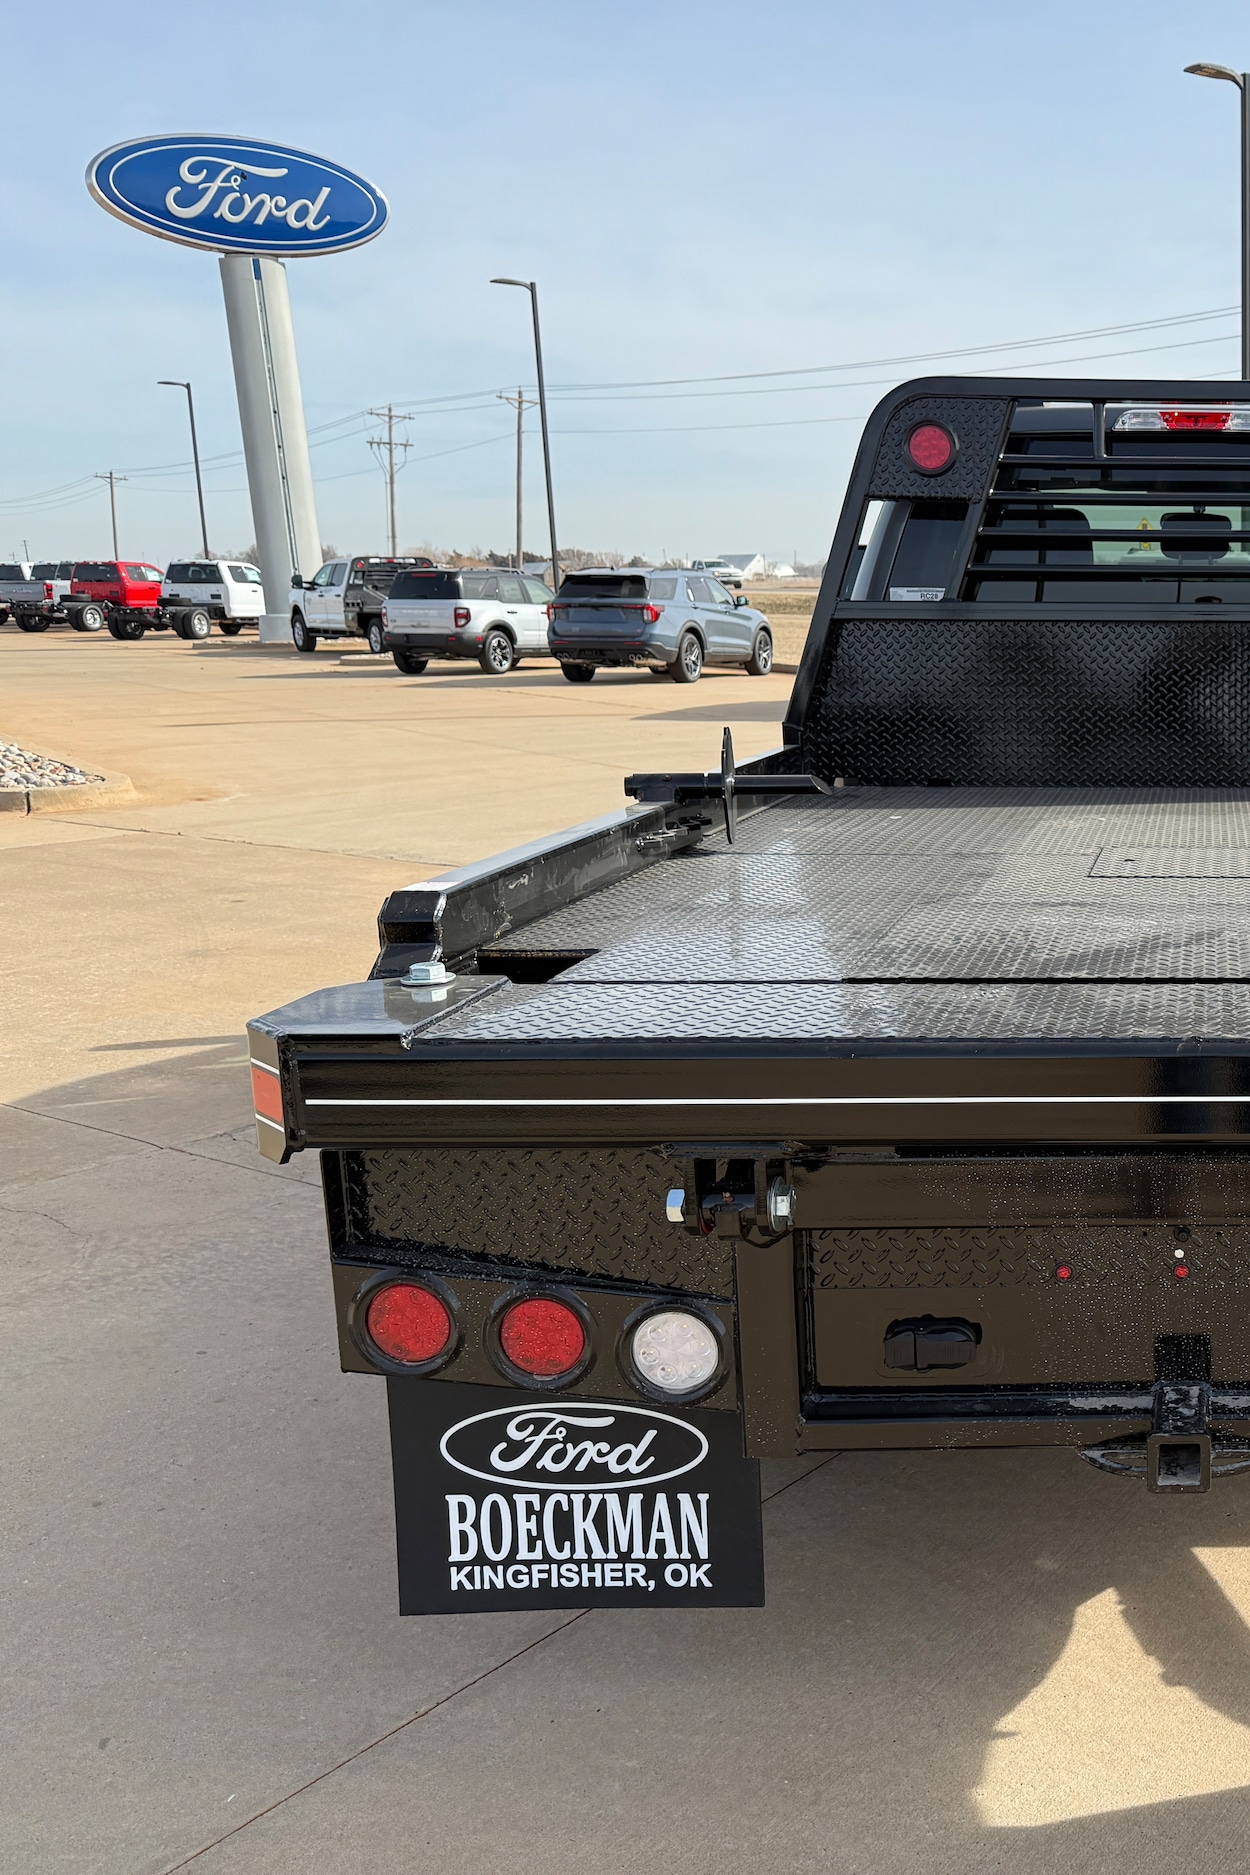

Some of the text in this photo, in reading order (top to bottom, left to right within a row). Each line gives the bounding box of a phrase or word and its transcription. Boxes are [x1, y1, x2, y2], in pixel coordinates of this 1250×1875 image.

[165, 156, 331, 231] Ford
[489, 1411, 658, 1474] Ford
[444, 1492, 710, 1563] BOECKMAN
[450, 1562, 713, 1592] KINGFISHER, OK
